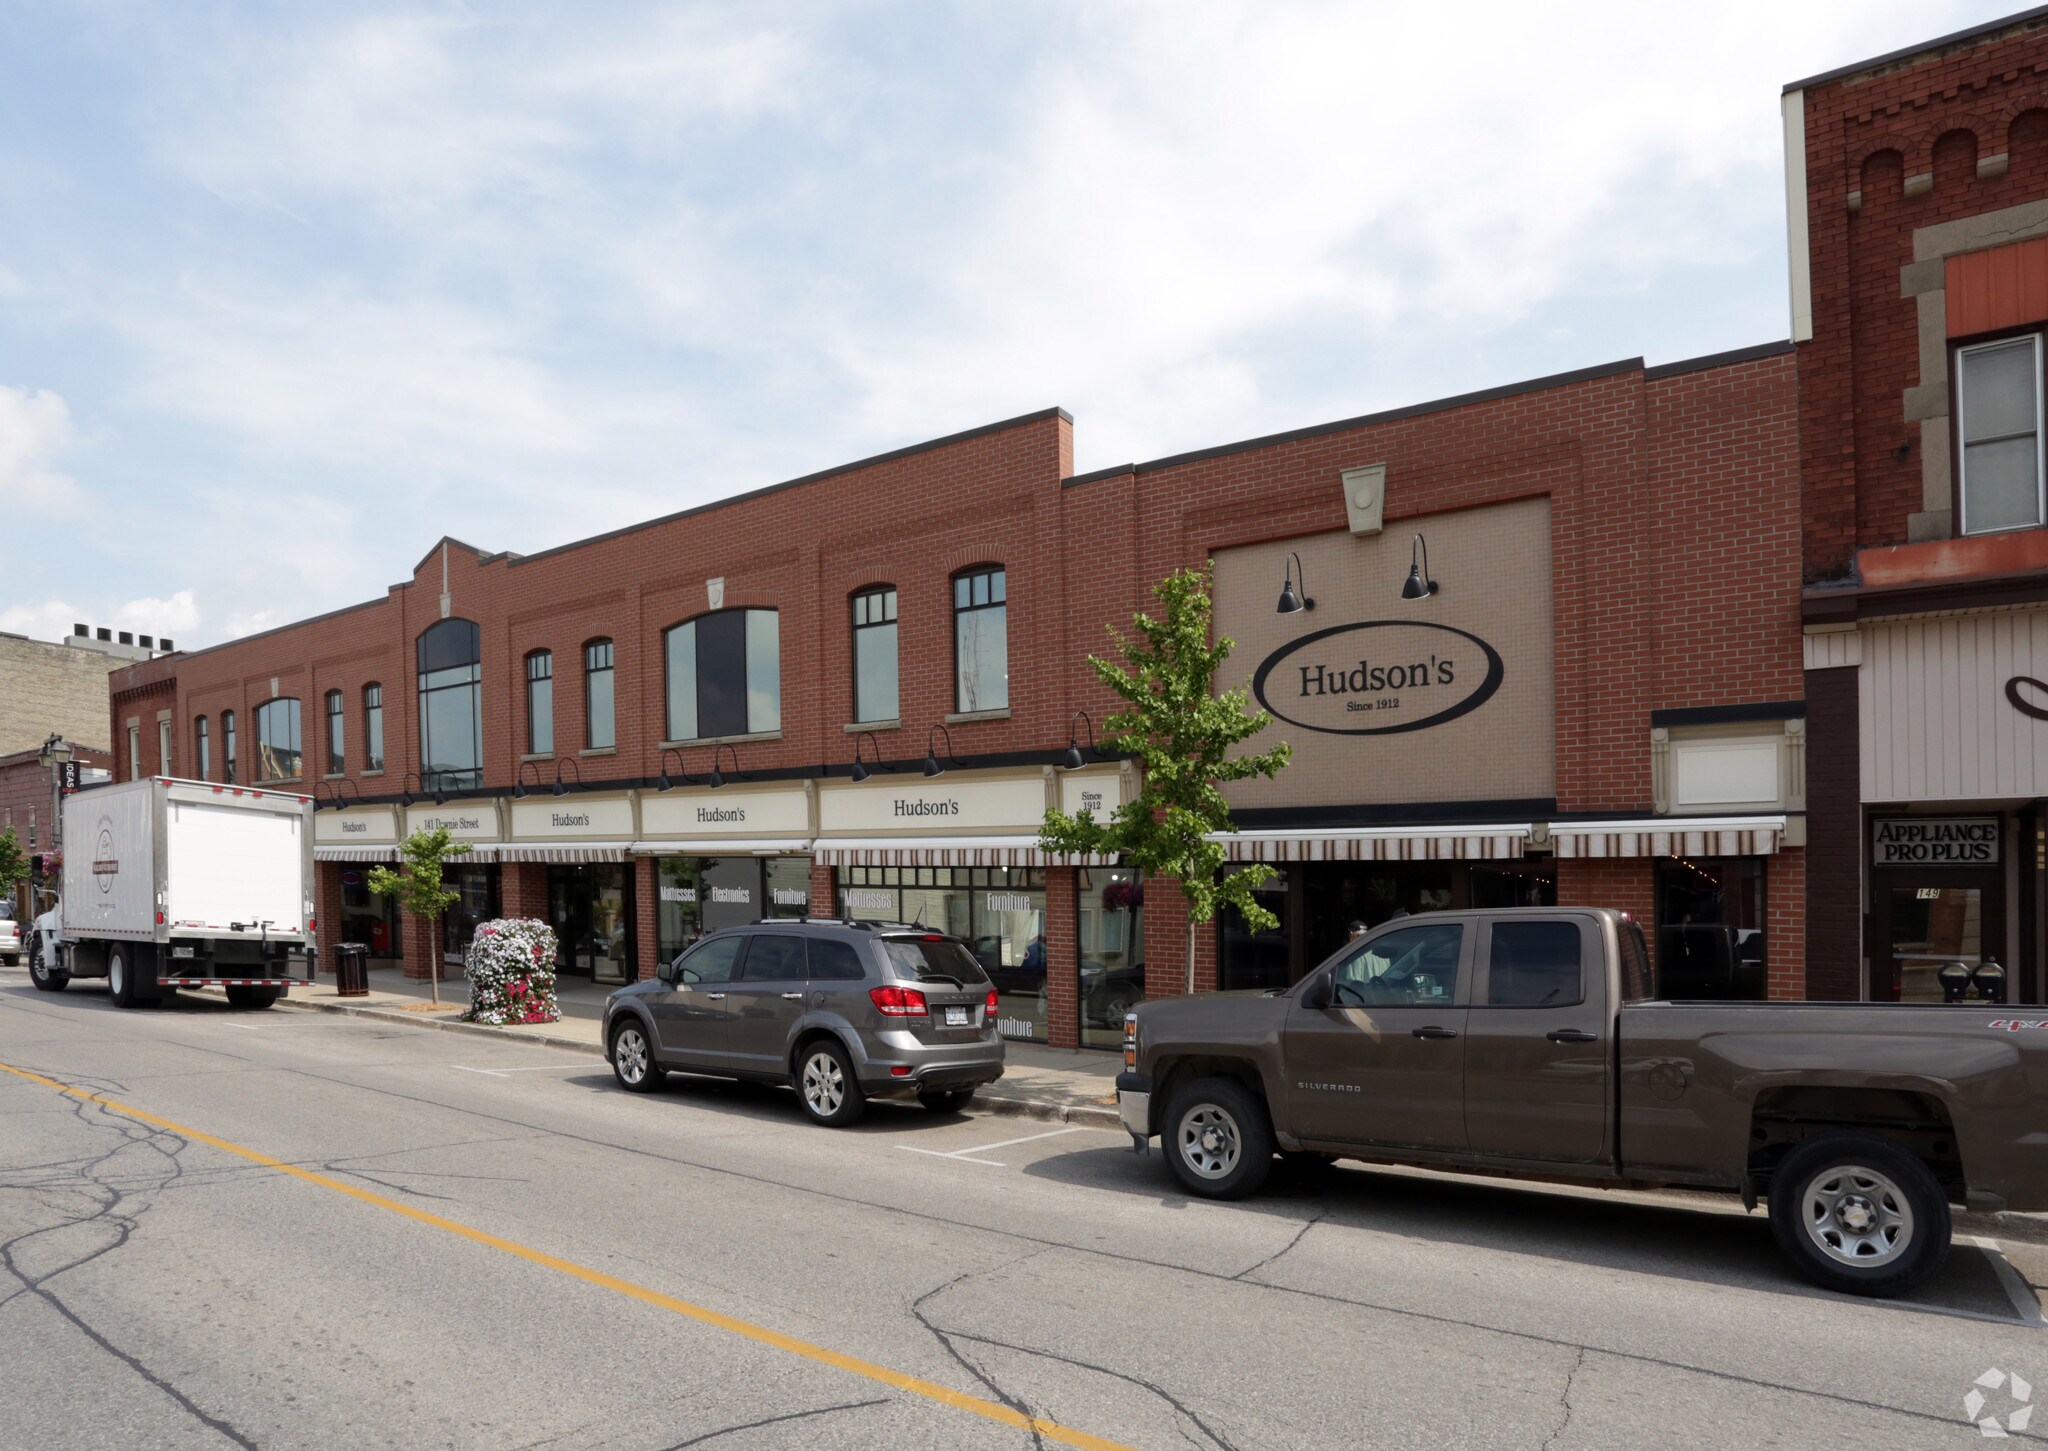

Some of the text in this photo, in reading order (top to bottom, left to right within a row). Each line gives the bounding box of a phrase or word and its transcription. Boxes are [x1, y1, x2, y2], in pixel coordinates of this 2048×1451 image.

[1299, 655, 1454, 696] Hudson's
[1347, 699, 1399, 711] Since 1912
[66, 763, 74, 788] IDEAS
[1082, 792, 1102, 800] Since
[893, 799, 959, 816] Hudson's
[1084, 801, 1101, 810] 1912
[552, 813, 589, 826] Hudson's
[697, 808, 745, 822] Hudson's
[342, 822, 367, 832] Hudson's
[424, 819, 434, 830] 141
[459, 817, 479, 829] Street
[1876, 823, 1996, 841] APPLIANCE
[1884, 843, 1991, 860] PRO PLUS
[660, 886, 696, 902] Mattresses
[712, 886, 749, 903] Electronics
[773, 887, 806, 905] Furniture
[844, 890, 892, 909] Mattresses
[987, 892, 1030, 911] Furniture
[1919, 889, 1939, 898] 149
[997, 1016, 1032, 1037] rniture
[1298, 1082, 1361, 1092] SILVERADO
